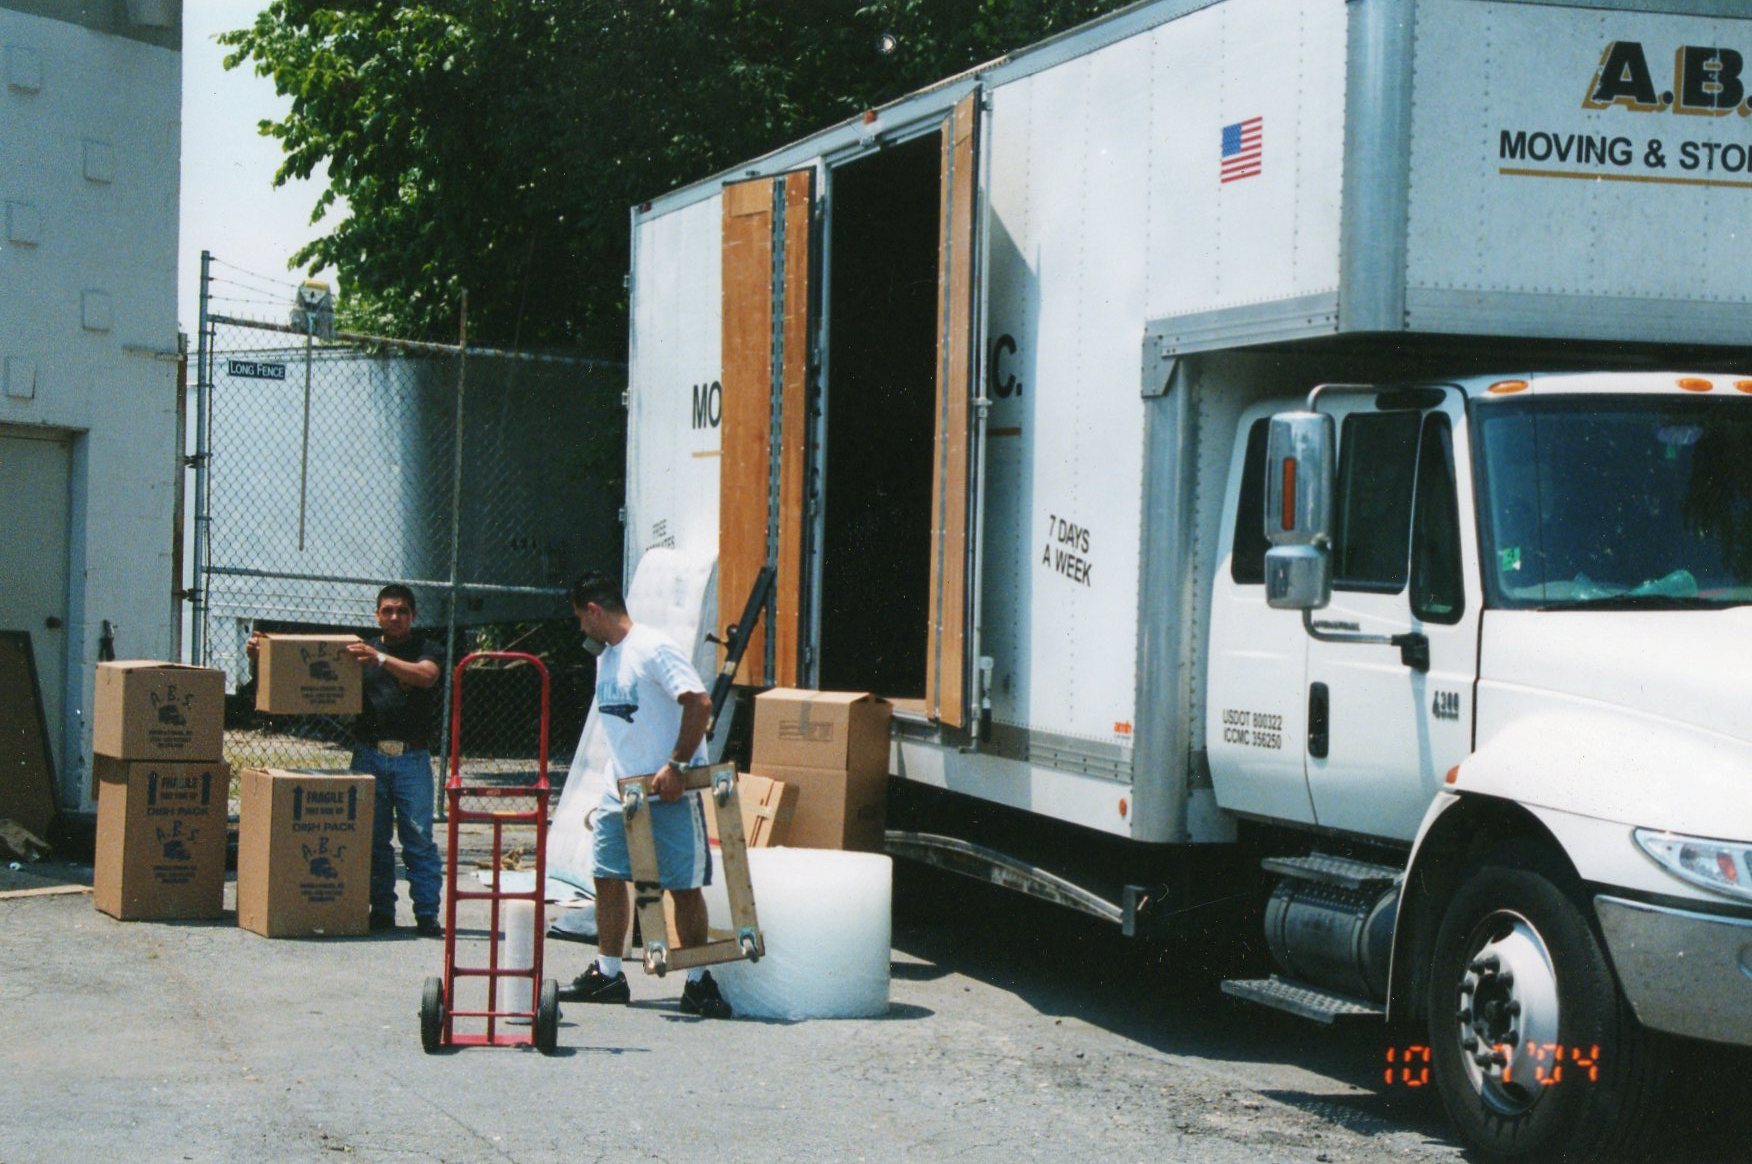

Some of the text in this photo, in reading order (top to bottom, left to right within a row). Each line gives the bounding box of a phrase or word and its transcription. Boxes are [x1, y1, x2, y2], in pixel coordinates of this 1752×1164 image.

[1500, 130, 1752, 173] MOVING & STO
[230, 360, 285, 378] LONG FENCE
[988, 333, 1022, 398] C.
[1050, 514, 1090, 554] 7 DAYS
[1042, 543, 1092, 588] A WEEK
[1223, 709, 1282, 731] USDOT 800322
[1224, 727, 1281, 750] ICCMC 356250
[306, 790, 344, 803] FRAGILE
[178, 807, 208, 816] PACK
[293, 822, 356, 832] DISH PACK
